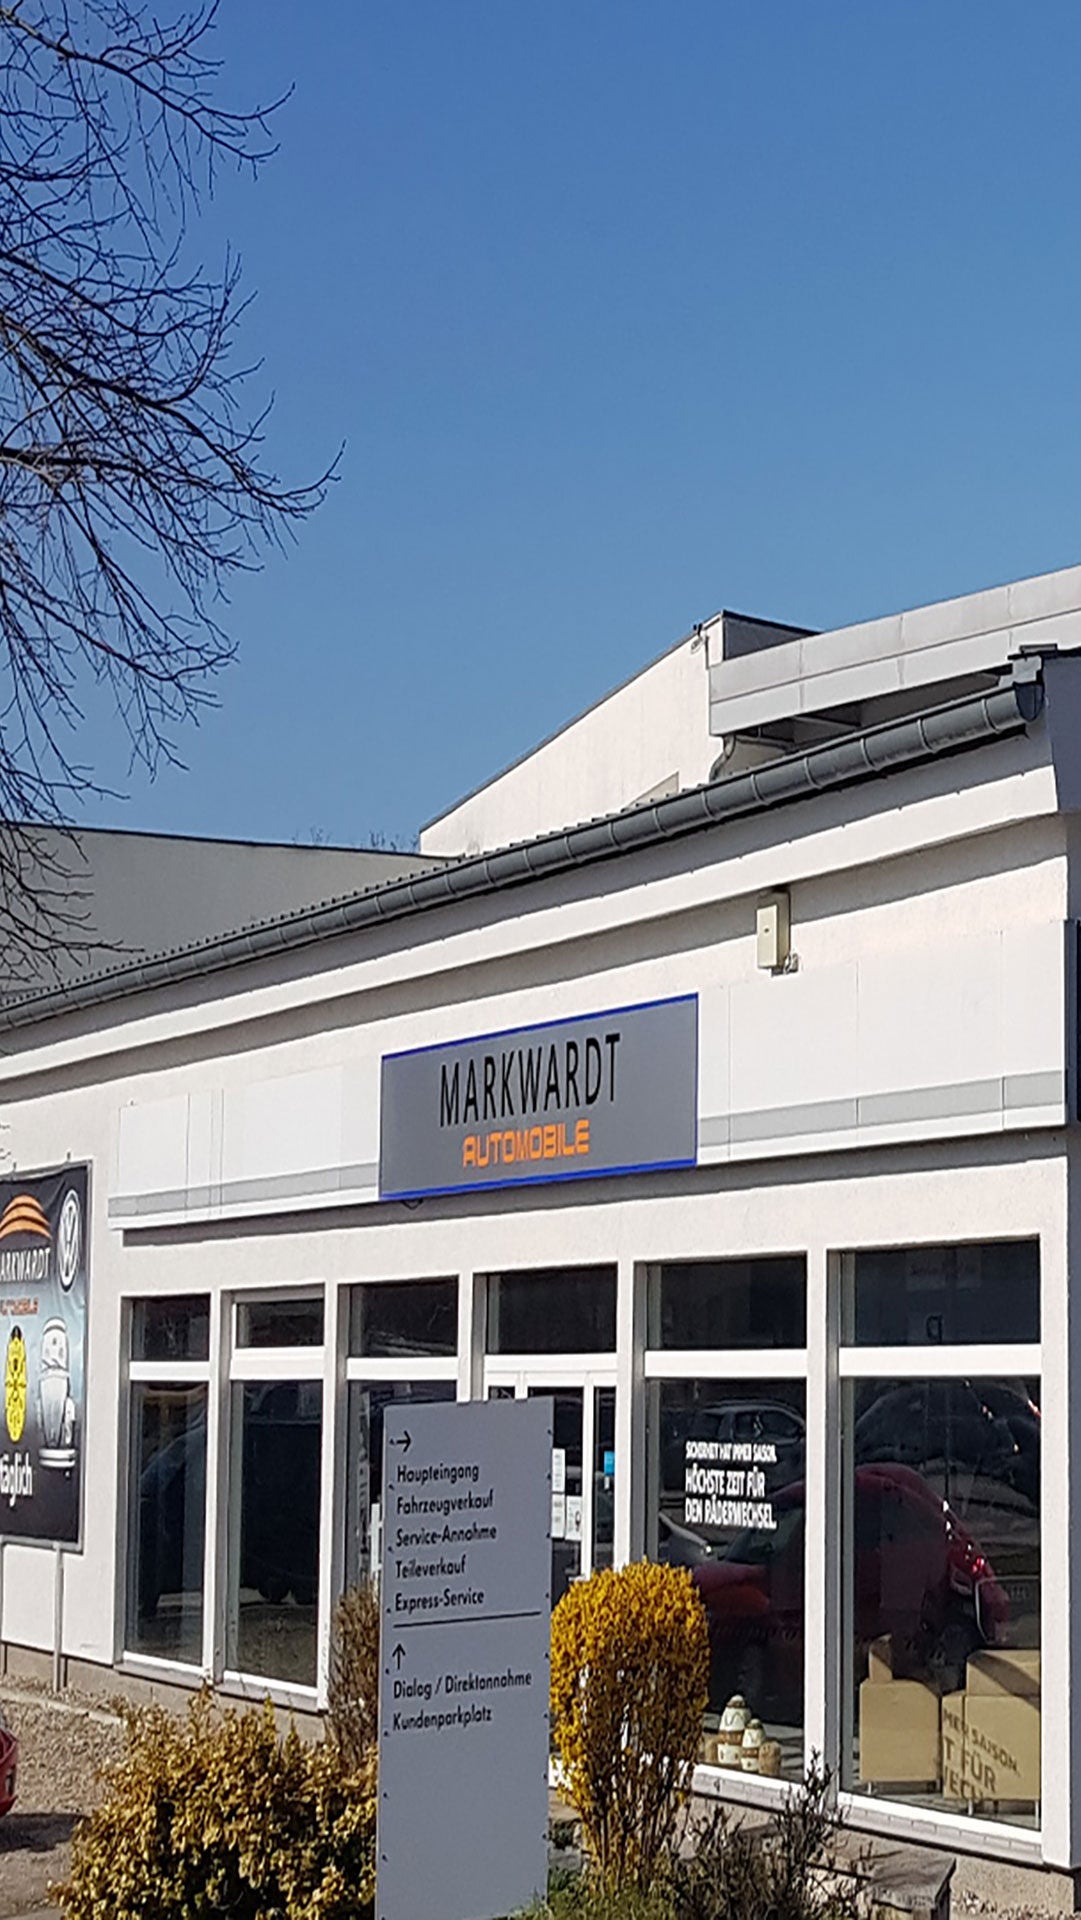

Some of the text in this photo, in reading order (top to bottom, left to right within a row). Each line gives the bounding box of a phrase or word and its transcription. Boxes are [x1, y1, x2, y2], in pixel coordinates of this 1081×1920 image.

[440, 1033, 620, 1127] MARKWARDT
[462, 1120, 590, 1168] AUTOMOBILE
[397, 1463, 479, 1485] Haupteingang
[685, 1463, 766, 1498] HÖCHSTE ZEIT FÜR
[397, 1489, 494, 1516] Fahrzeugverkauf
[685, 1498, 703, 1523] DEN
[396, 1522, 497, 1547] Service-Annahme
[395, 1554, 467, 1578] Teileverkauf
[395, 1587, 485, 1614] Express-Service
[393, 1678, 432, 1701] Dialog
[445, 1667, 532, 1694] Direktannahme
[393, 1704, 492, 1731] Kundenparkplatz
[962, 1750, 996, 1793] FÜR
